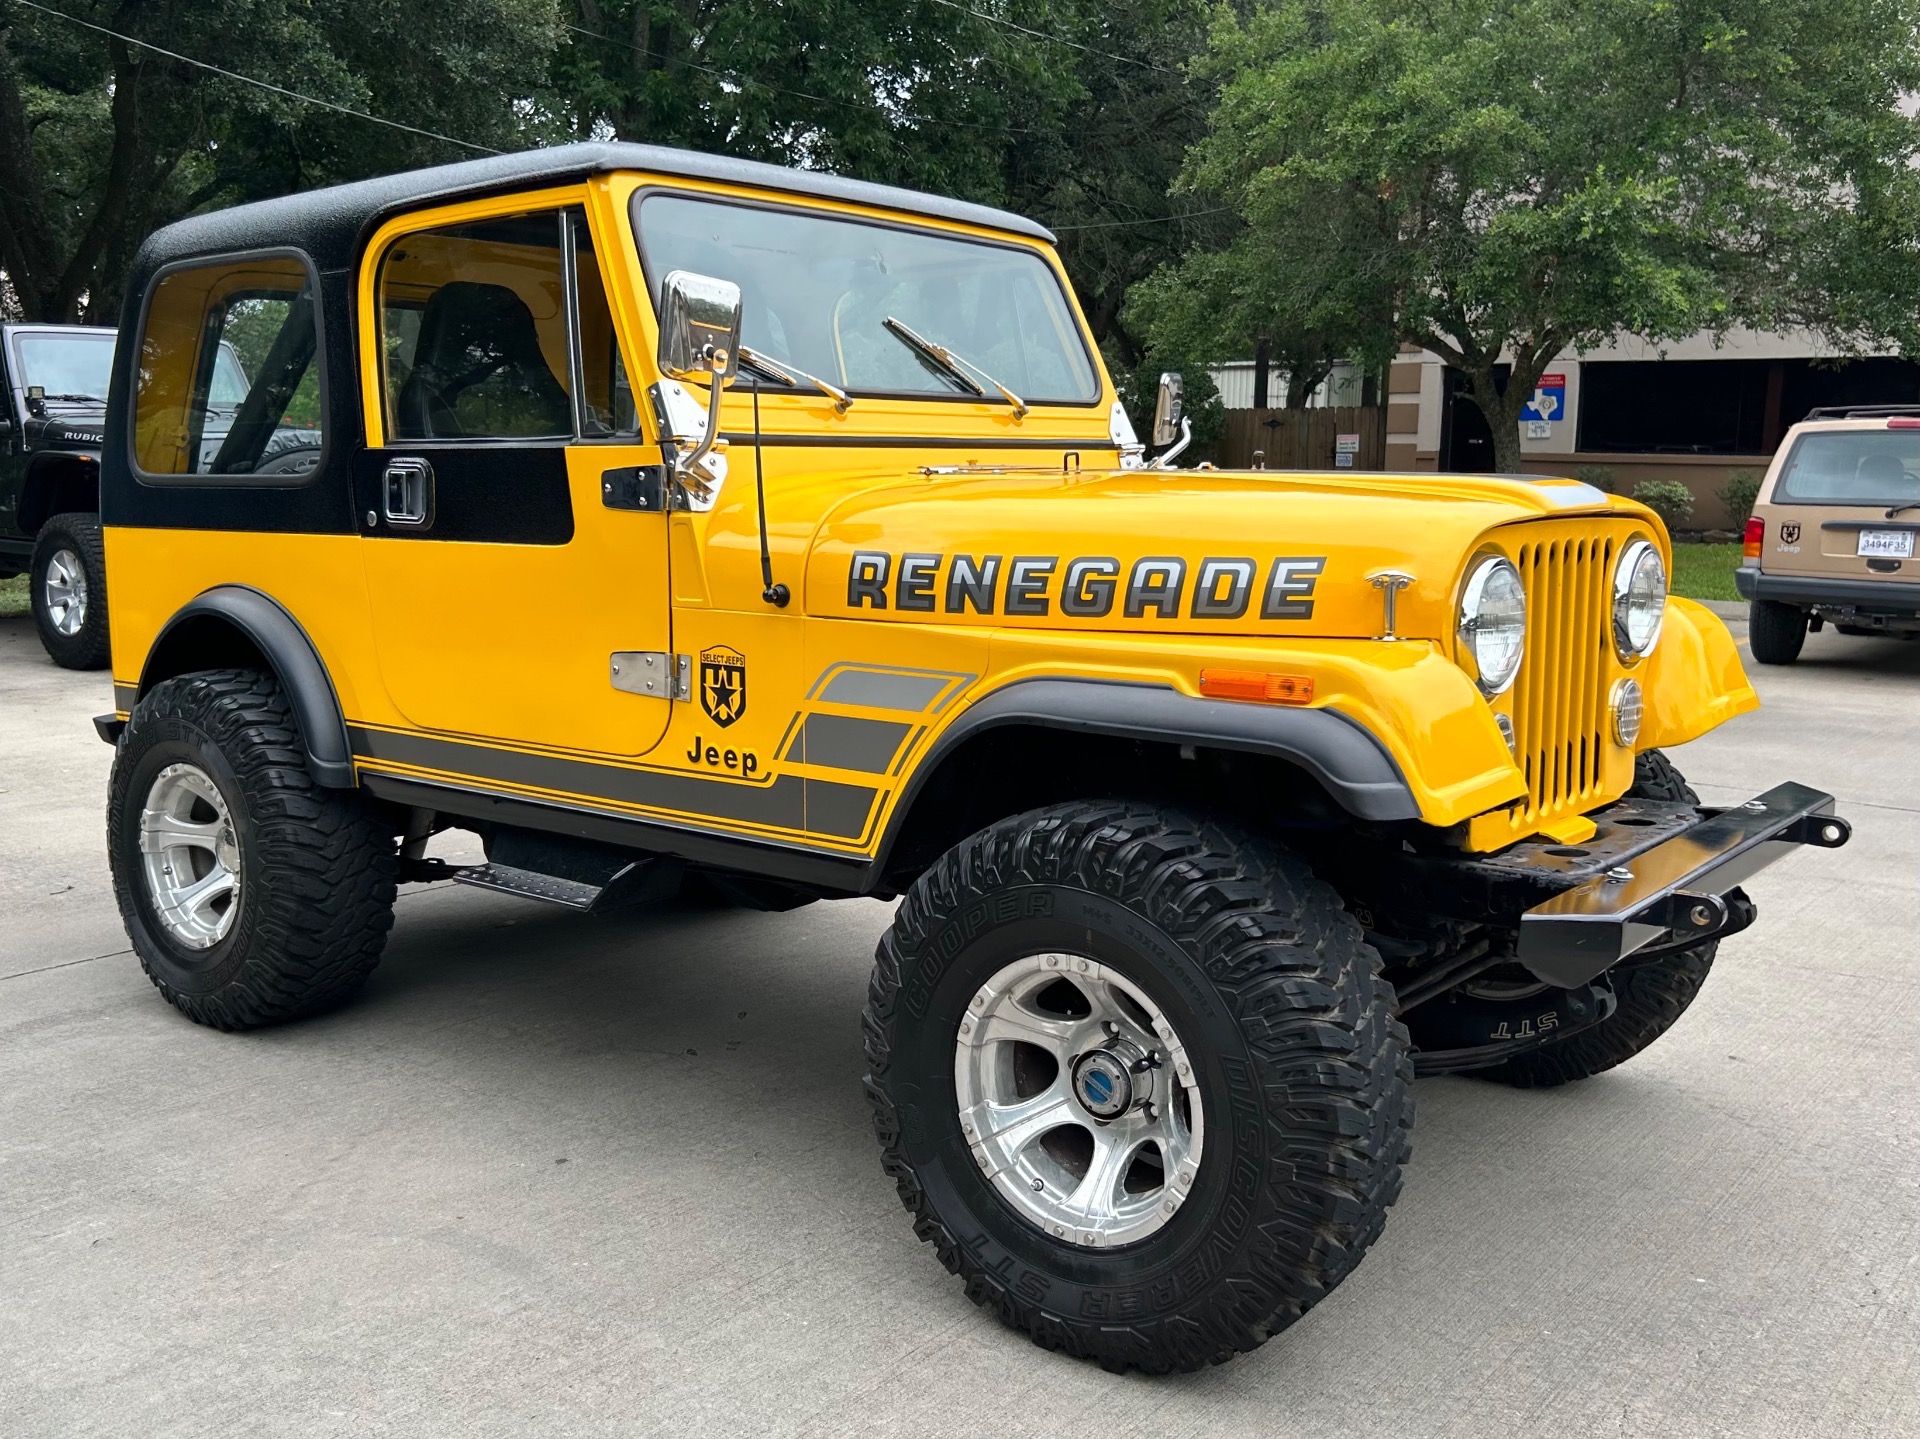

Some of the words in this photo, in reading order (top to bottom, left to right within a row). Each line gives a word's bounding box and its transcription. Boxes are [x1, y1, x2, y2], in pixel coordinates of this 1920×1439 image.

[1776, 544, 1801, 554] Jeep
[1864, 539, 1906, 549] 3494F35
[847, 550, 1327, 620] RENEGADE
[702, 653, 725, 664] SELECT
[725, 655, 744, 666] JEEPS
[687, 736, 757, 776] Jeep
[904, 888, 1055, 1020] COOPER
[1490, 1011, 1559, 1039] STT
[1080, 1053, 1261, 1319] DISCOVERER
[960, 1233, 1051, 1301] STT
